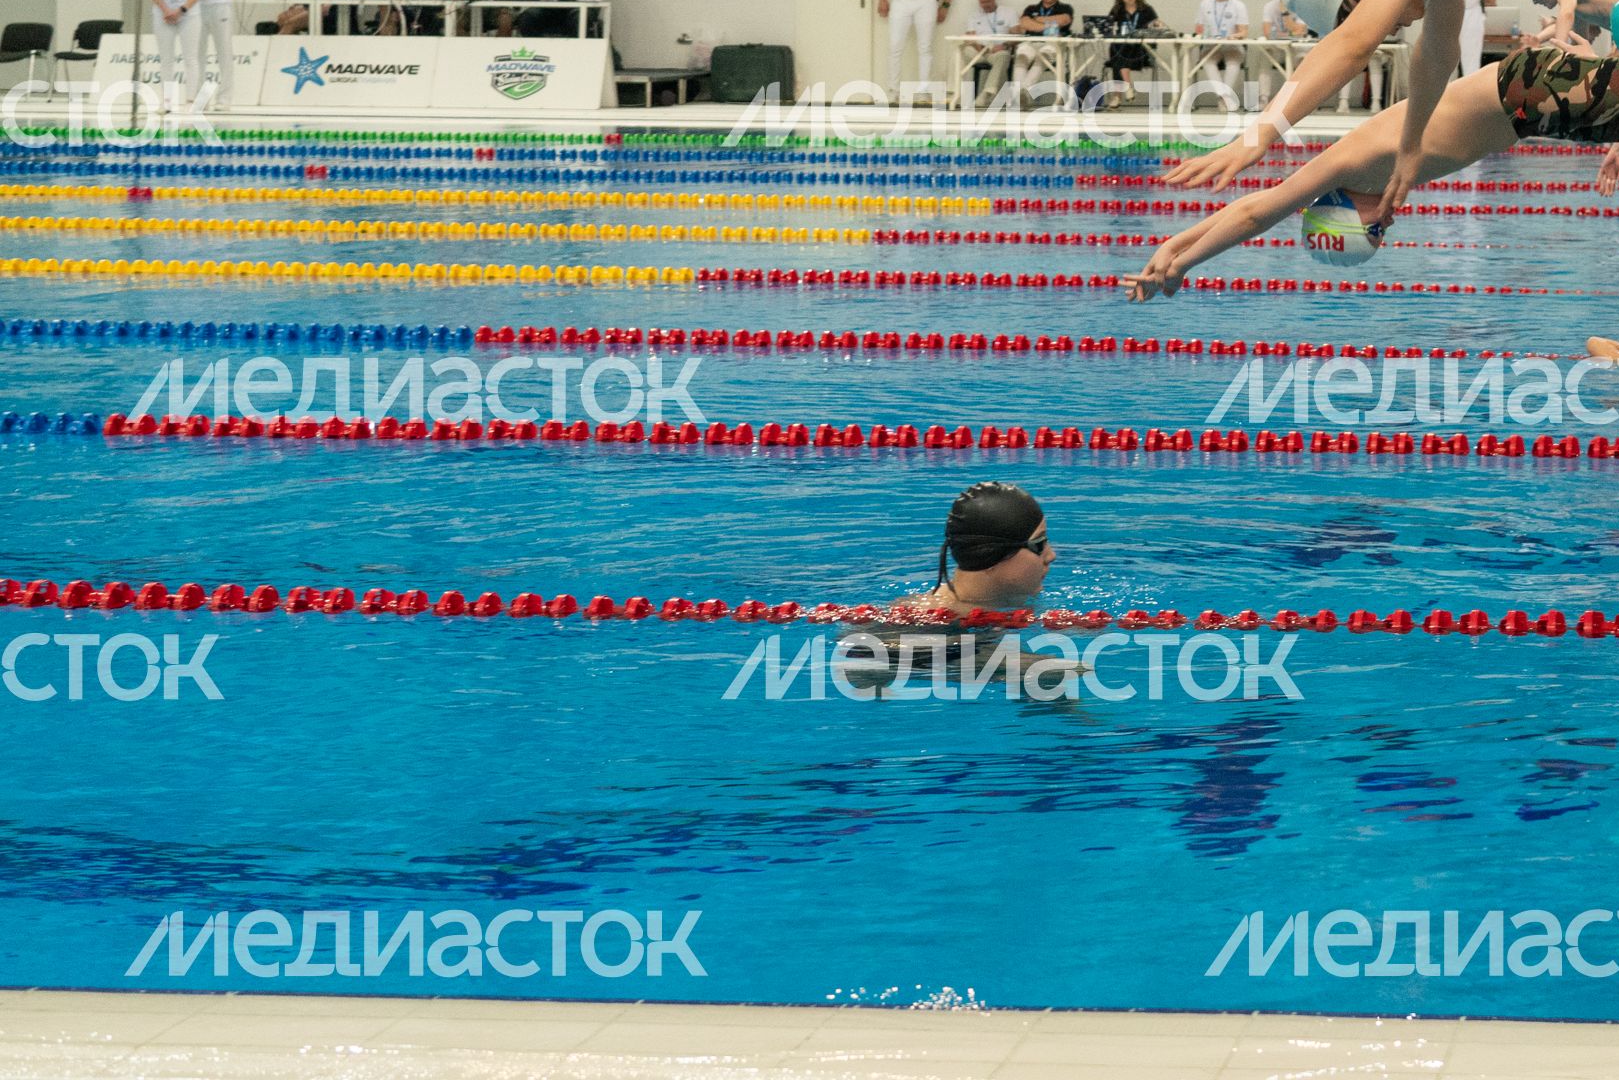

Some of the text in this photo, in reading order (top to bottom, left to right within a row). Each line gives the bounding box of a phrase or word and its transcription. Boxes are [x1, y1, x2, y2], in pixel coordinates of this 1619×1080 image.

[325, 63, 421, 75] MADWAVE
[486, 62, 556, 72] MADWAVE
[1306, 231, 1345, 252] RUS
